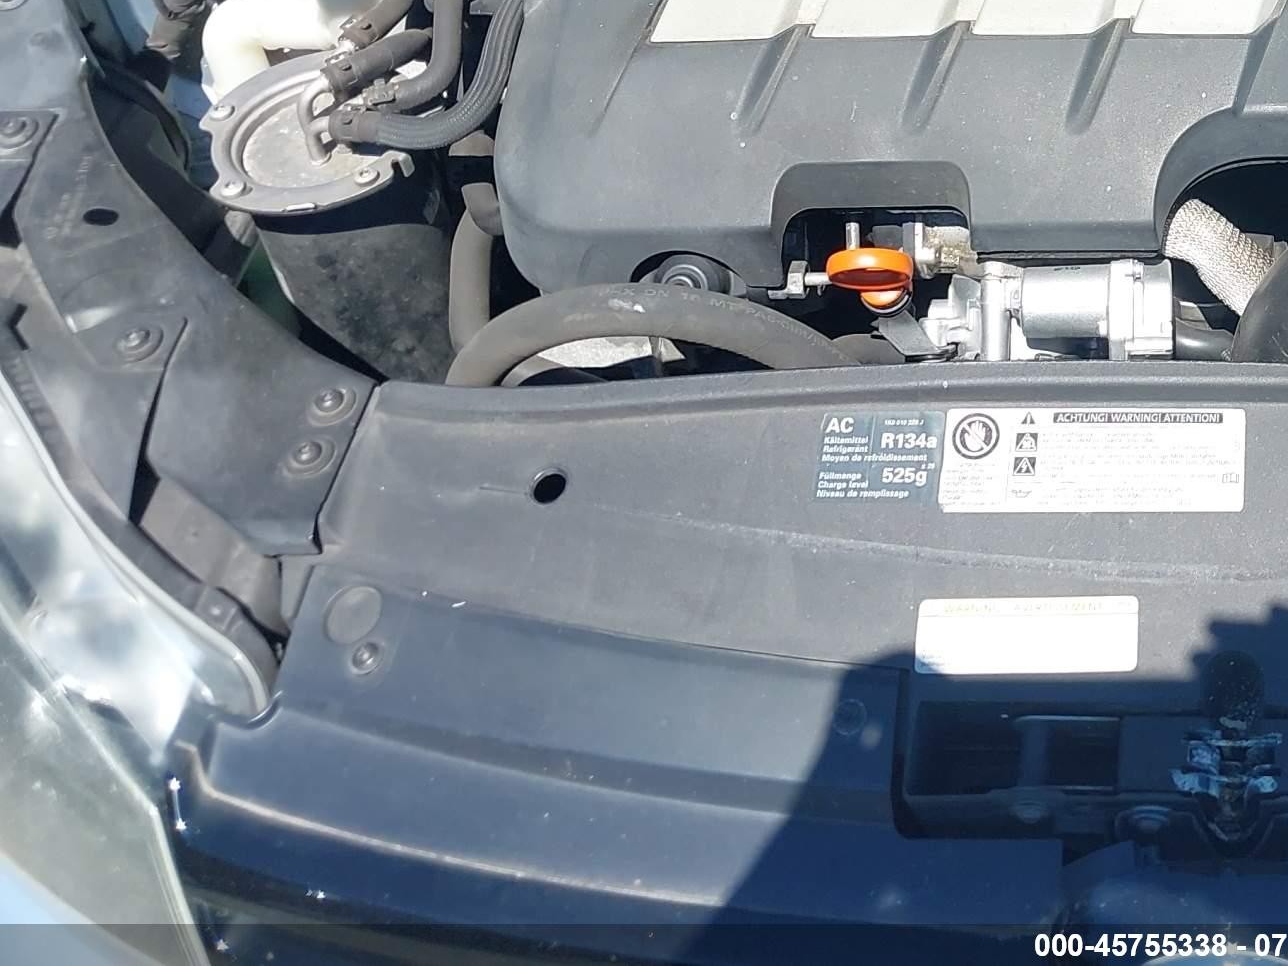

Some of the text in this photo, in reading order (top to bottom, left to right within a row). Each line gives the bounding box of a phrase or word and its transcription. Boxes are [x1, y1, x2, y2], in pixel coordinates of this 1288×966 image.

[1056, 412, 1220, 423] ACHTUNG! WARNING! ATTENTION!
[825, 417, 854, 434] AC
[824, 435, 869, 445] Kältemittel
[881, 432, 938, 449] R134a
[823, 445, 868, 455] Refrigerant
[821, 454, 849, 464] Moyen
[851, 454, 862, 462] de
[818, 472, 862, 481] Füllmenge
[881, 467, 928, 487] 525g
[817, 479, 869, 490] Charge level
[816, 489, 910, 499] Niveau de remplissage
